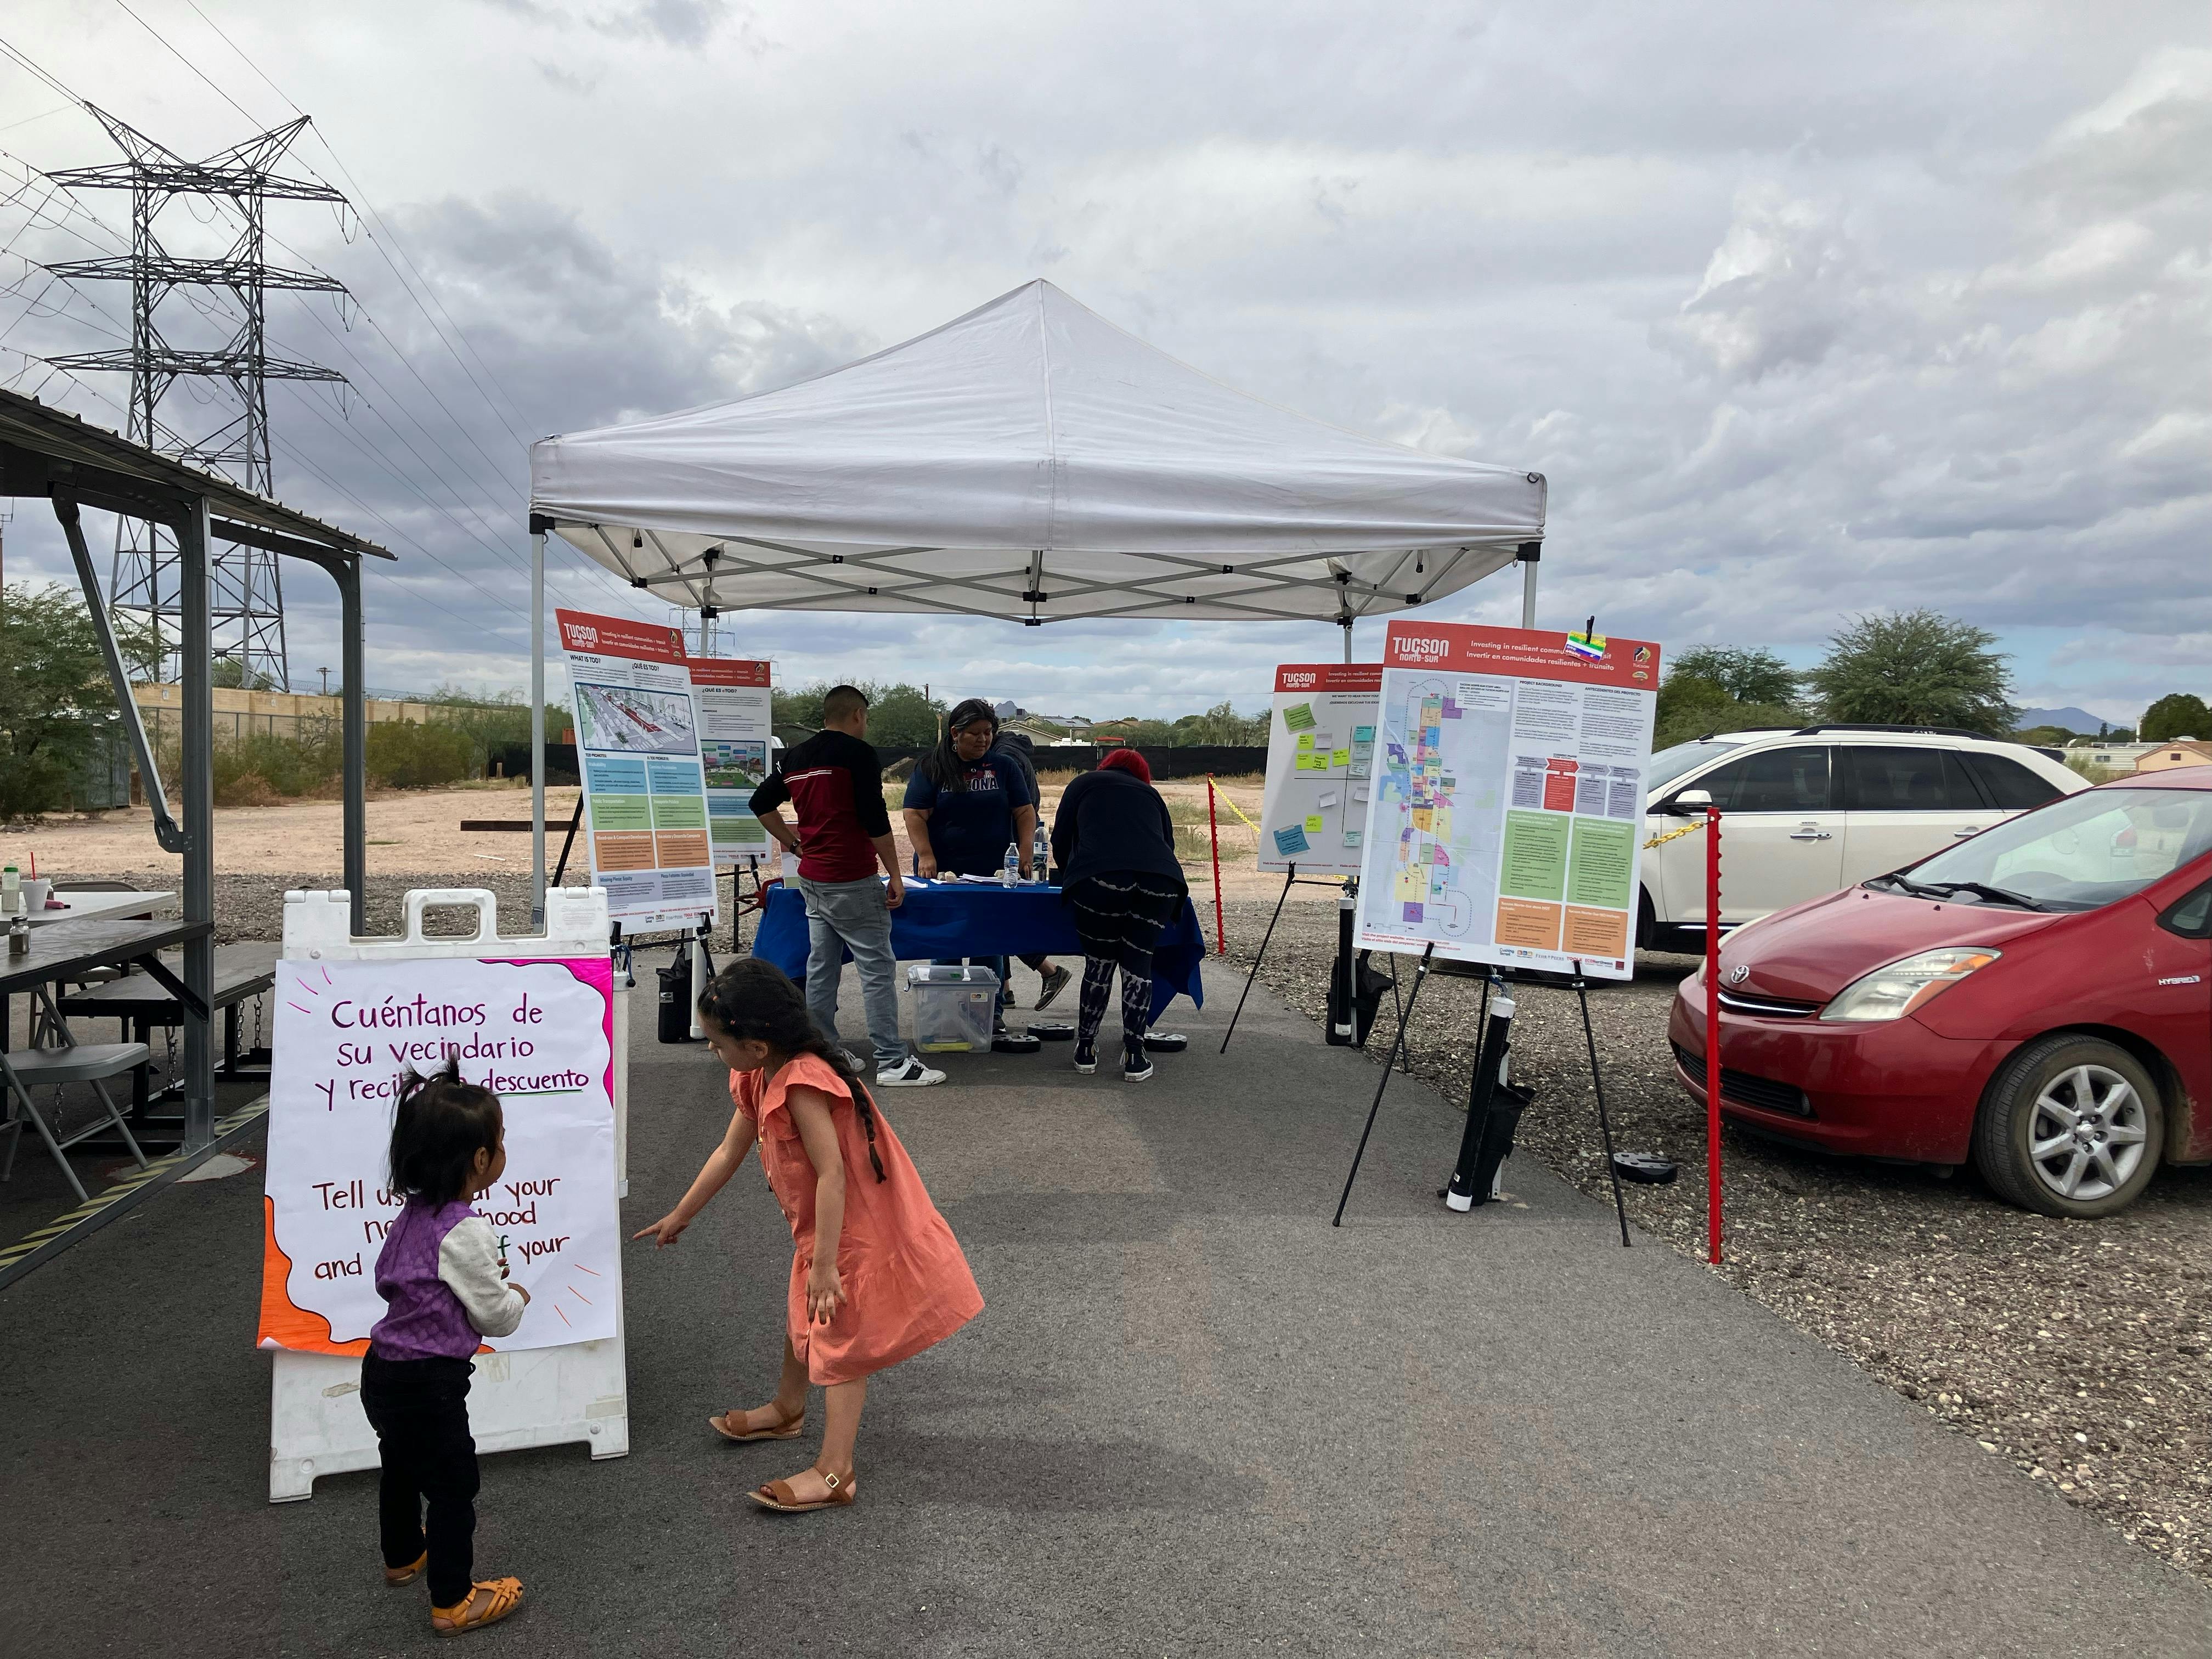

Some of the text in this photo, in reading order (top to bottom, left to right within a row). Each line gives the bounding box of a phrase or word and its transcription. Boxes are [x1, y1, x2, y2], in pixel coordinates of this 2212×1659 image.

[563, 623, 599, 644] TUCSON
[1392, 636, 1449, 657] TUCSON
[1471, 640, 1501, 650] Investing
[1511, 644, 1538, 652] resilient
[1466, 651, 1490, 659] Invertir
[1502, 656, 1547, 665] comunidades
[1548, 658, 1581, 668] resilientes
[1282, 673, 1316, 684] TUCSON
[2158, 977, 2196, 986] HYBRID
[331, 992, 543, 1029] Cuéntanos de
[388, 1031, 534, 1065] vecindario
[480, 1068, 590, 1092] descuento
[312, 1179, 364, 1211] Tell
[376, 1188, 405, 1207] us
[504, 1177, 561, 1207] your
[314, 1235, 571, 1281] and your
